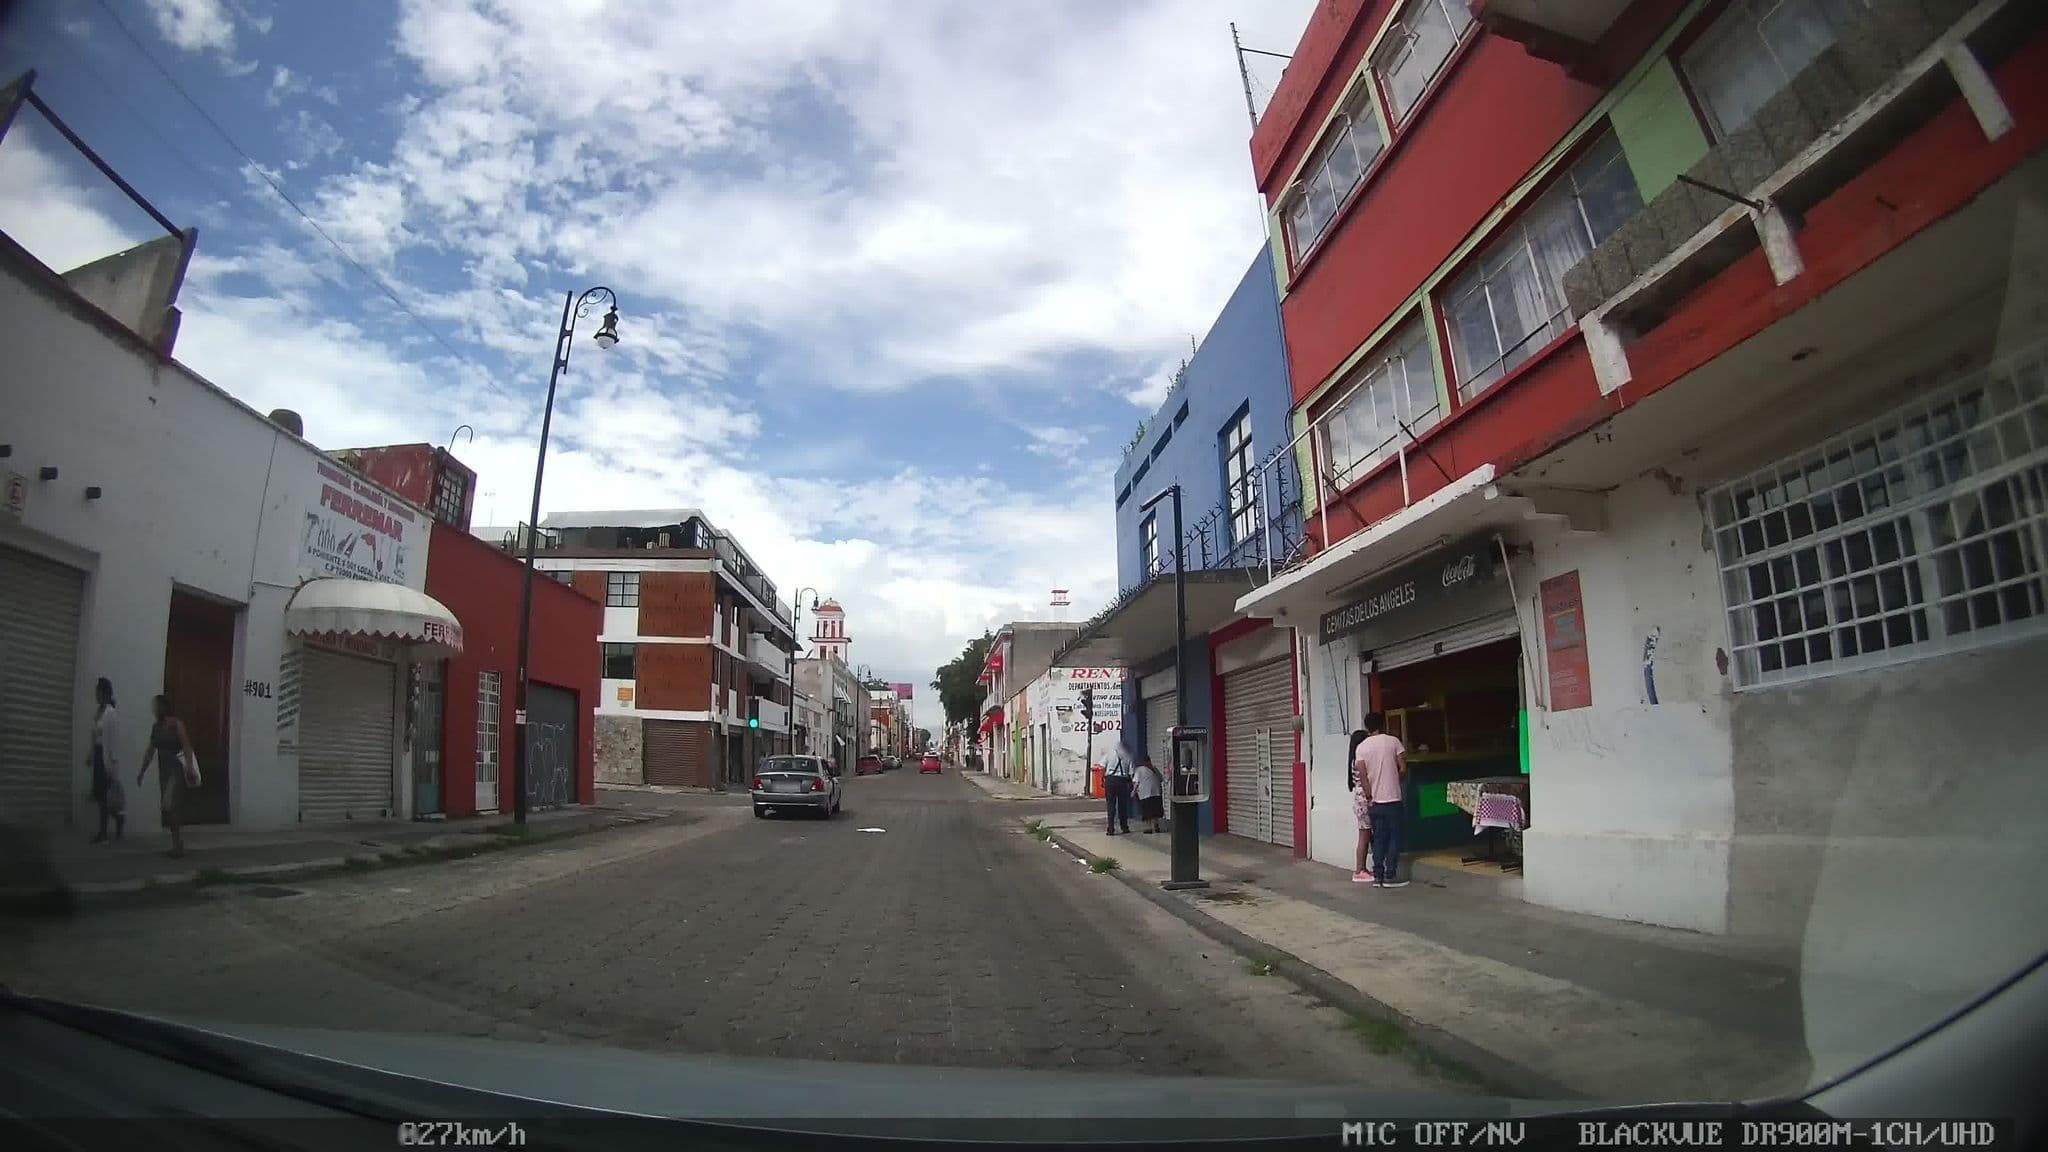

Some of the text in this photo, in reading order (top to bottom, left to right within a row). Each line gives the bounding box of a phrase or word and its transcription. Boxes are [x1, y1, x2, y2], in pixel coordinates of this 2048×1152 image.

[1326, 581, 1416, 634] CEMITAS DE LOS ANGELES
[243, 679, 272, 699] #901
